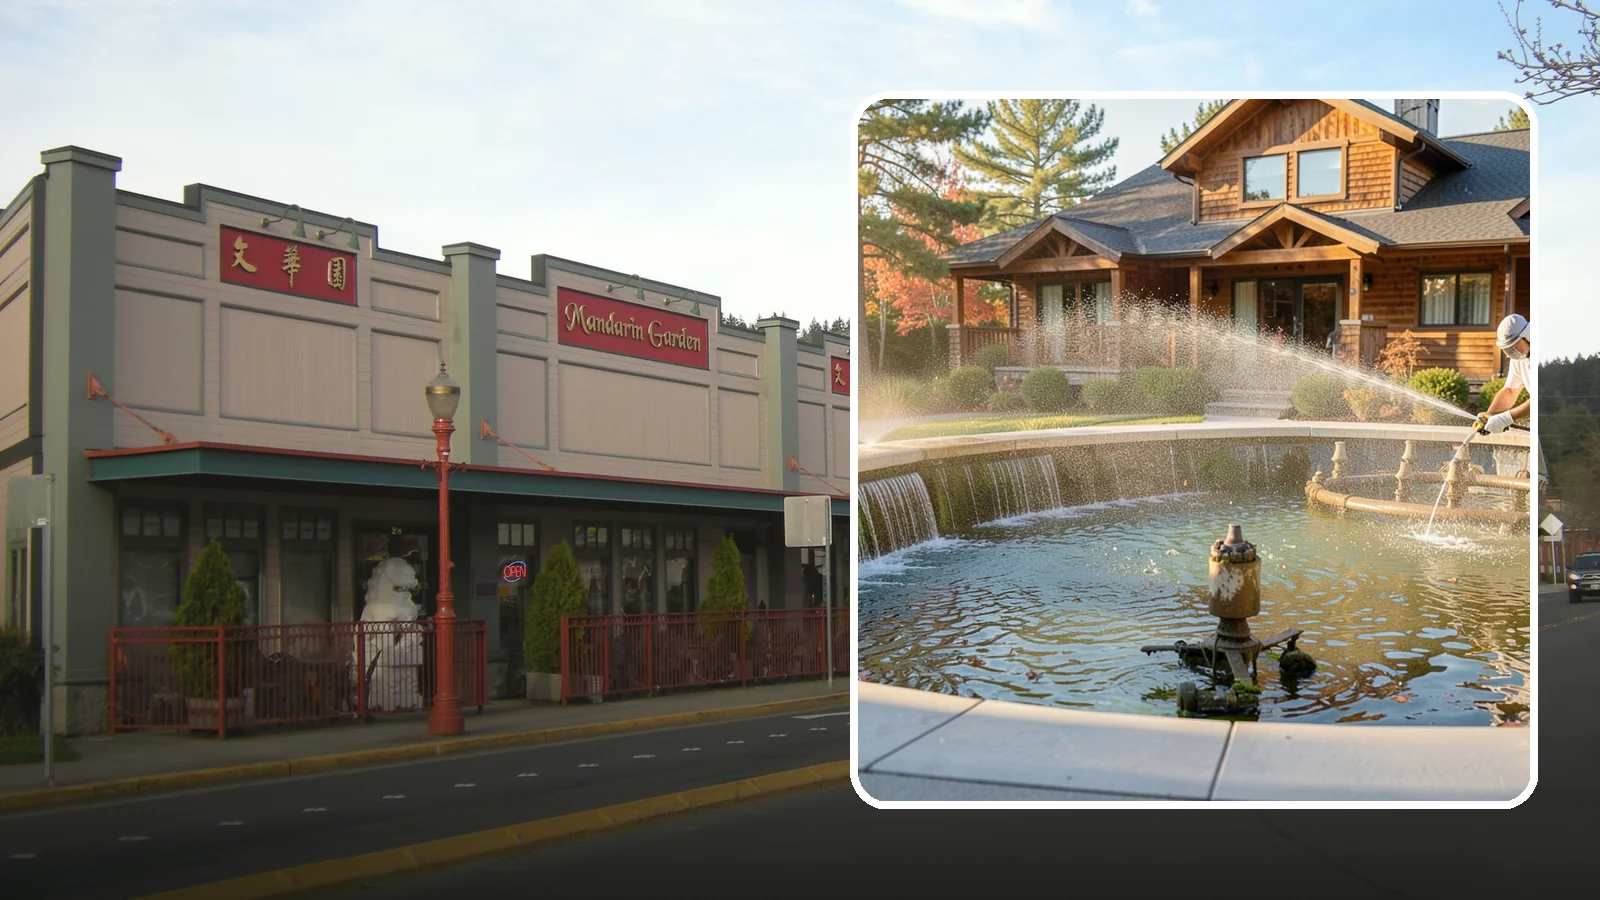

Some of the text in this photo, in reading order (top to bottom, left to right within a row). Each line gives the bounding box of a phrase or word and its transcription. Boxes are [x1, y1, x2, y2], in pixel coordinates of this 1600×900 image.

[564, 302, 701, 352] Mandarin Garden
[503, 565, 527, 578] OPEN
